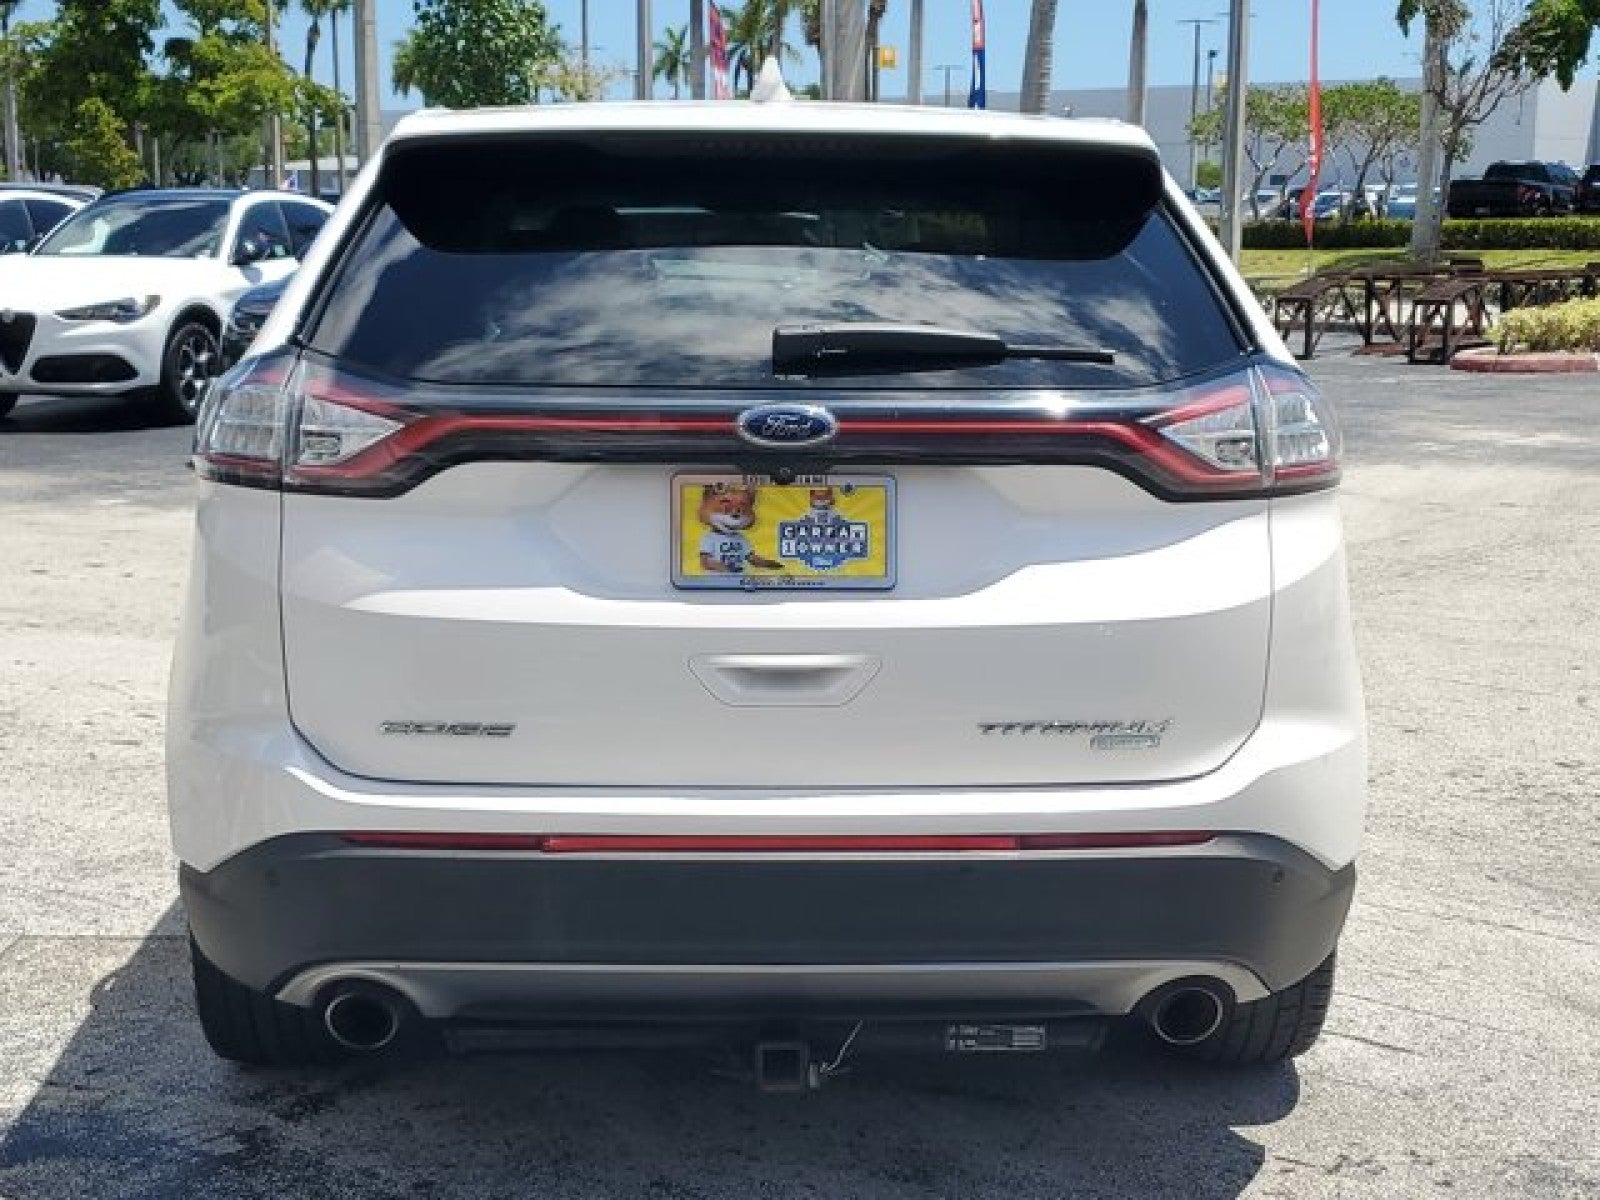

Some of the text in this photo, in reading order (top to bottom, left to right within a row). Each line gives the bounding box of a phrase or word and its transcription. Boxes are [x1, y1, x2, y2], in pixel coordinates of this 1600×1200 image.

[761, 414, 814, 437] Ford
[797, 541, 864, 554] OWNER
[379, 720, 517, 736] EDGE
